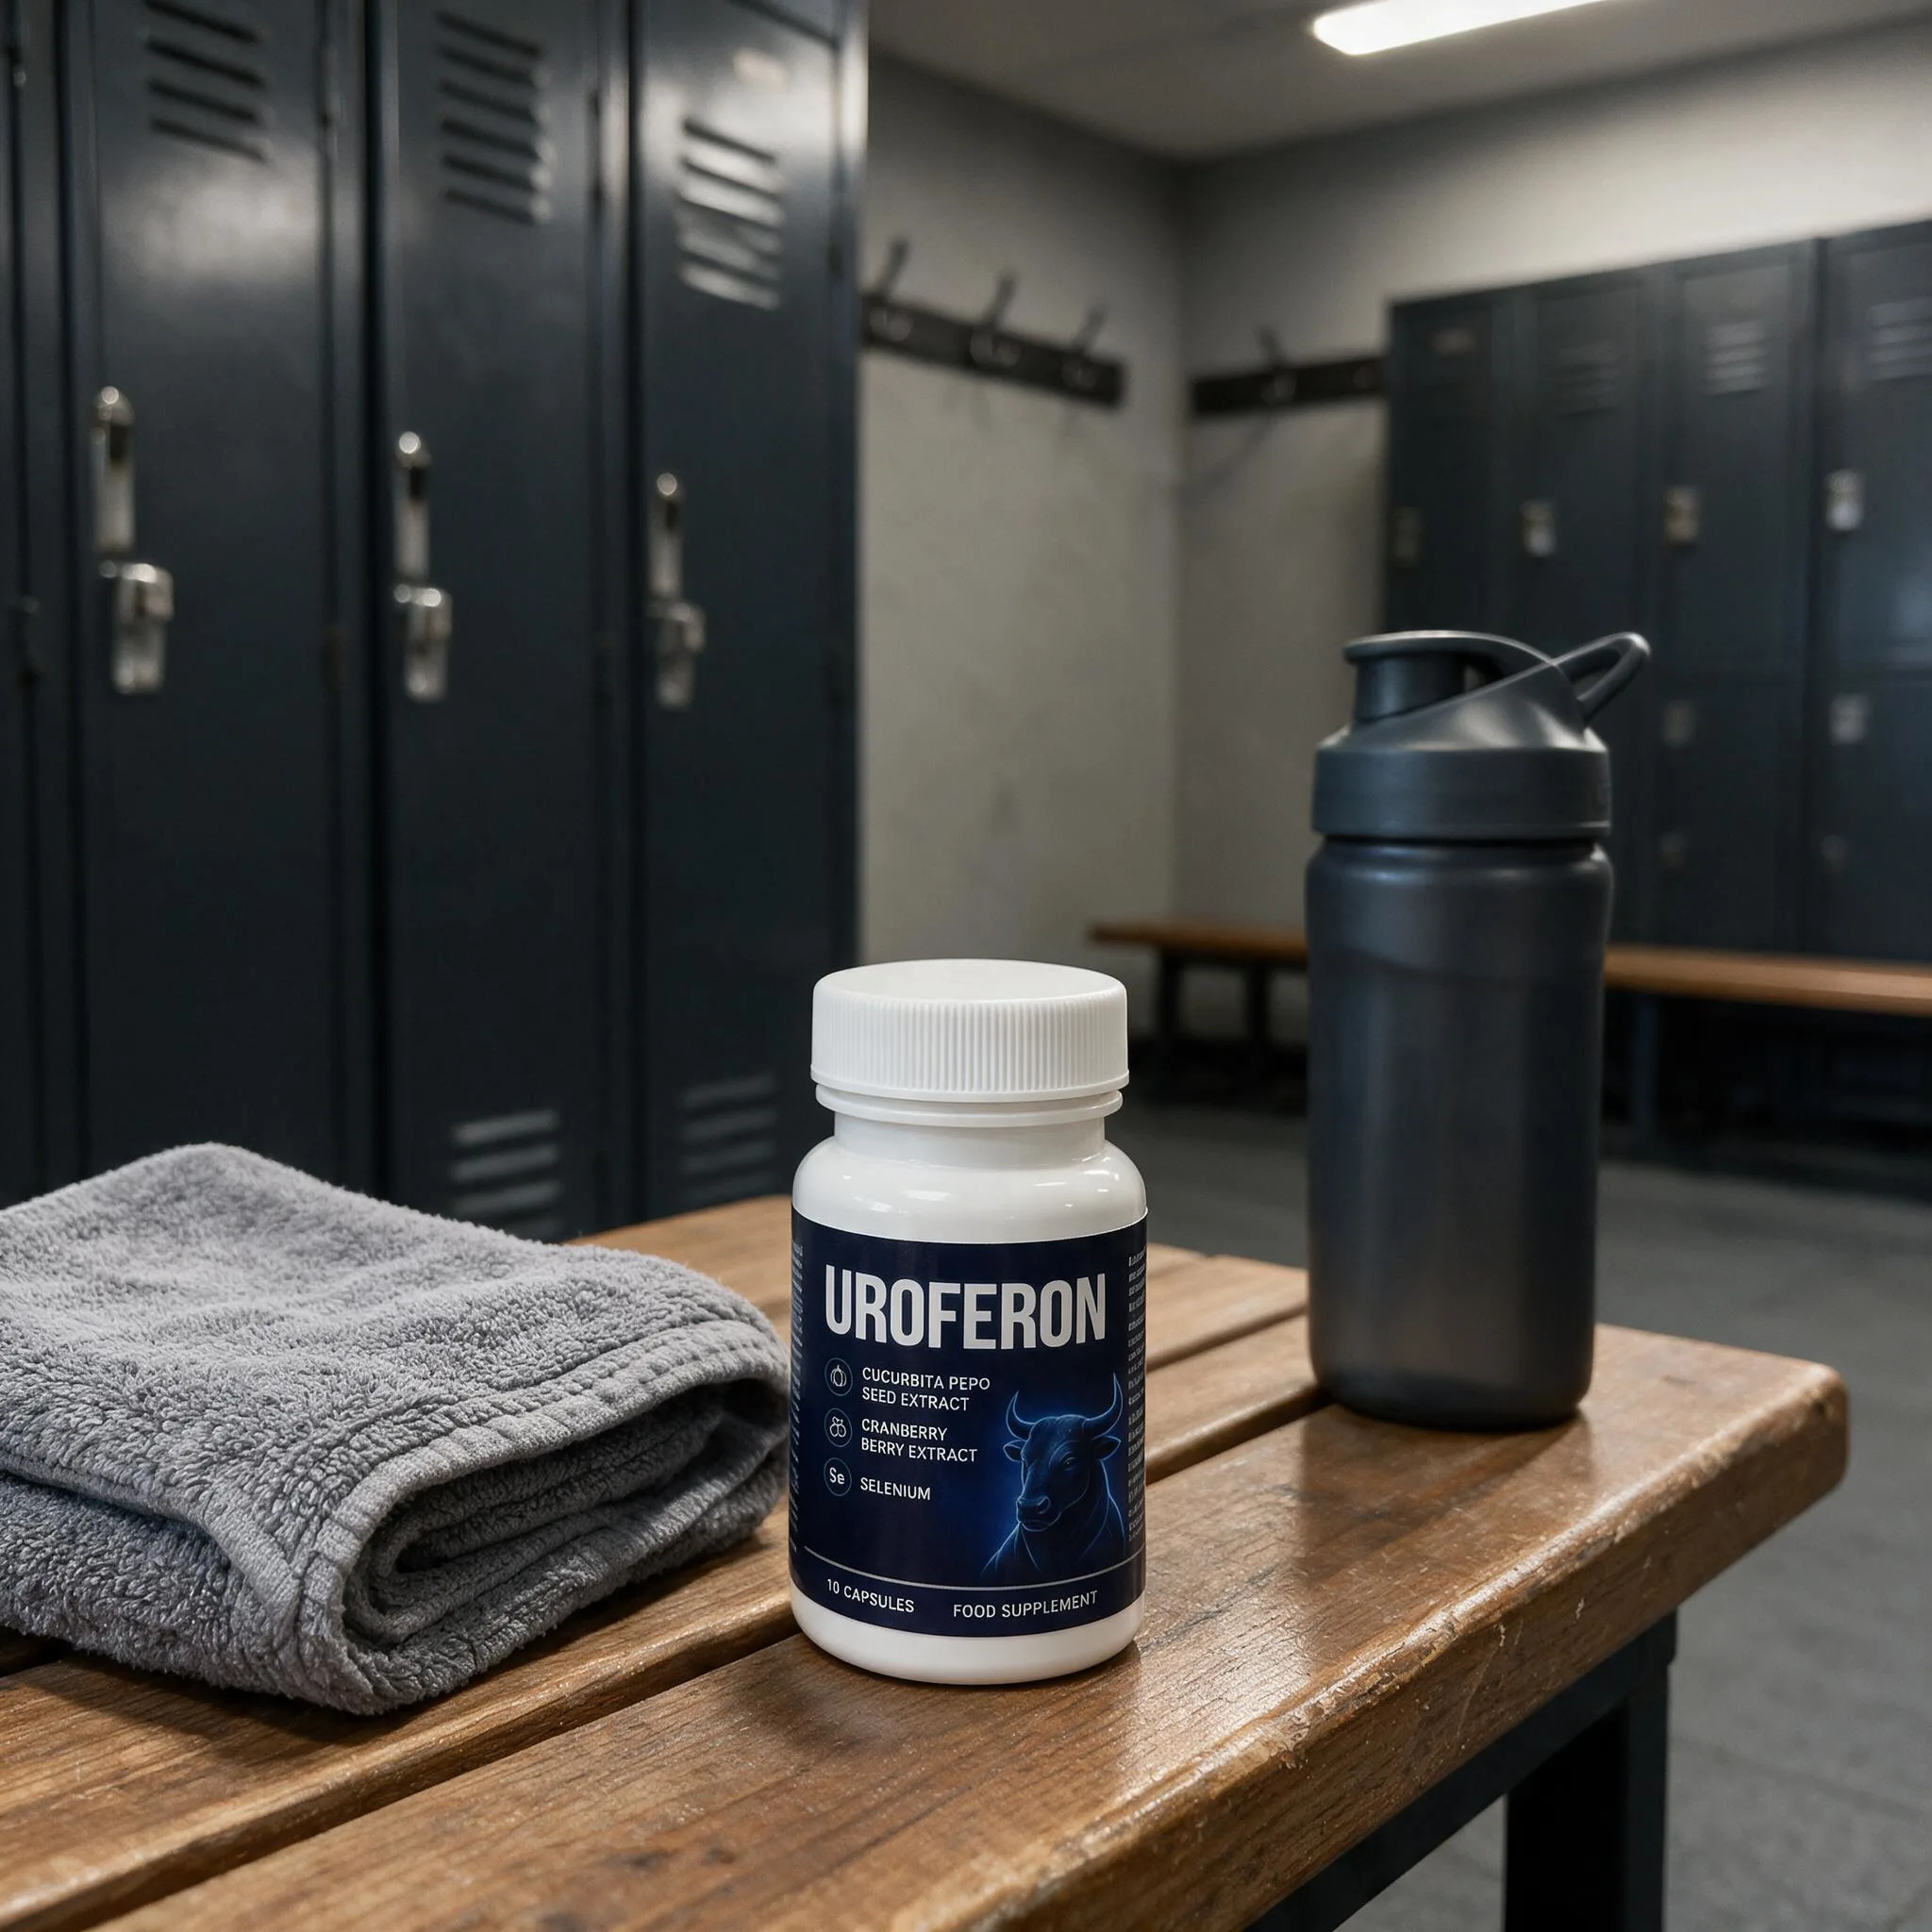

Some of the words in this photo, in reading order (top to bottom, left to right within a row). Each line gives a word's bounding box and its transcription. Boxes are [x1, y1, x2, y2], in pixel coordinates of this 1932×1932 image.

[825, 1264, 1106, 1350] UROFERON
[862, 1366, 944, 1390] CUCURBITA
[949, 1375, 991, 1391] PEPO
[861, 1386, 896, 1405] SEED
[901, 1392, 970, 1411] EXTRACT
[861, 1418, 948, 1441] CRANBERRY
[861, 1437, 905, 1457] BERRY
[908, 1444, 978, 1462] EXTRACT
[829, 1467, 845, 1485] Se
[859, 1476, 931, 1501] SELENIUM
[826, 1578, 840, 1594] 10
[843, 1585, 915, 1613] CAPSULES
[953, 1604, 996, 1619] FOOD
[1001, 1590, 1098, 1618] SUPPLEMENT
